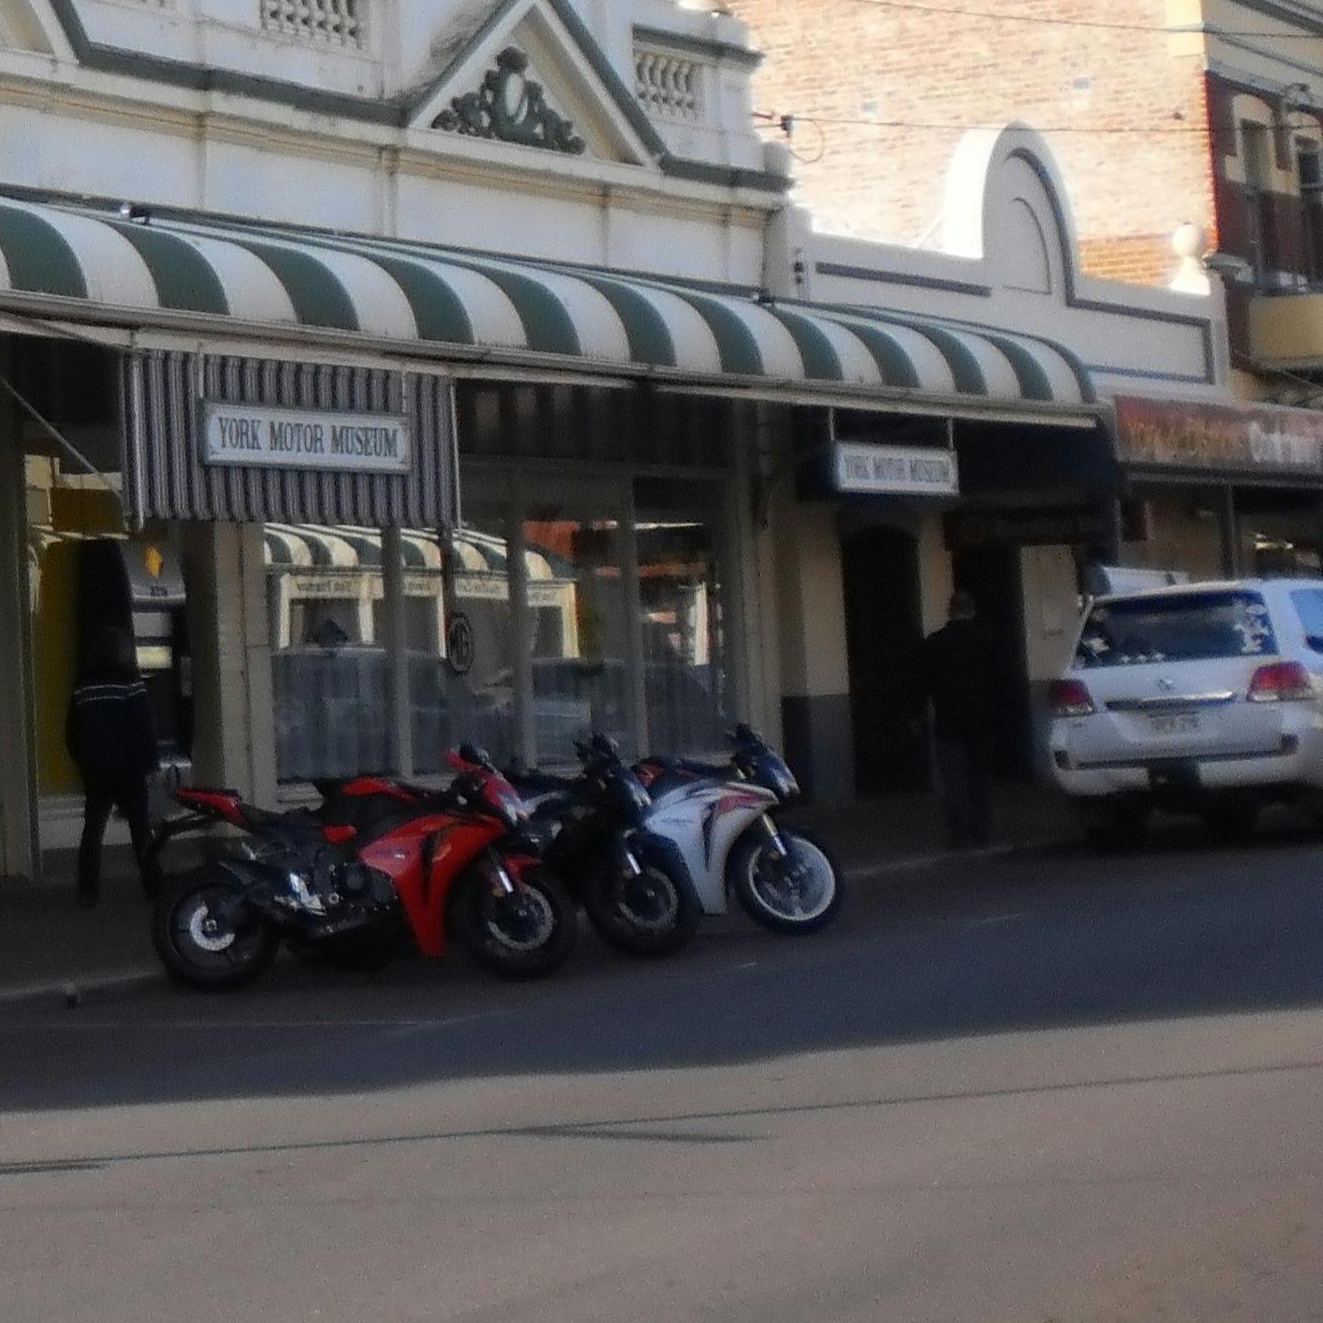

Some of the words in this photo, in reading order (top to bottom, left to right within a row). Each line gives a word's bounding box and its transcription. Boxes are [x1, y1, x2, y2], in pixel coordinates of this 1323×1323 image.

[218, 416, 262, 450] YORK
[269, 421, 324, 454] MOTOR
[331, 425, 398, 458] MUSEUM
